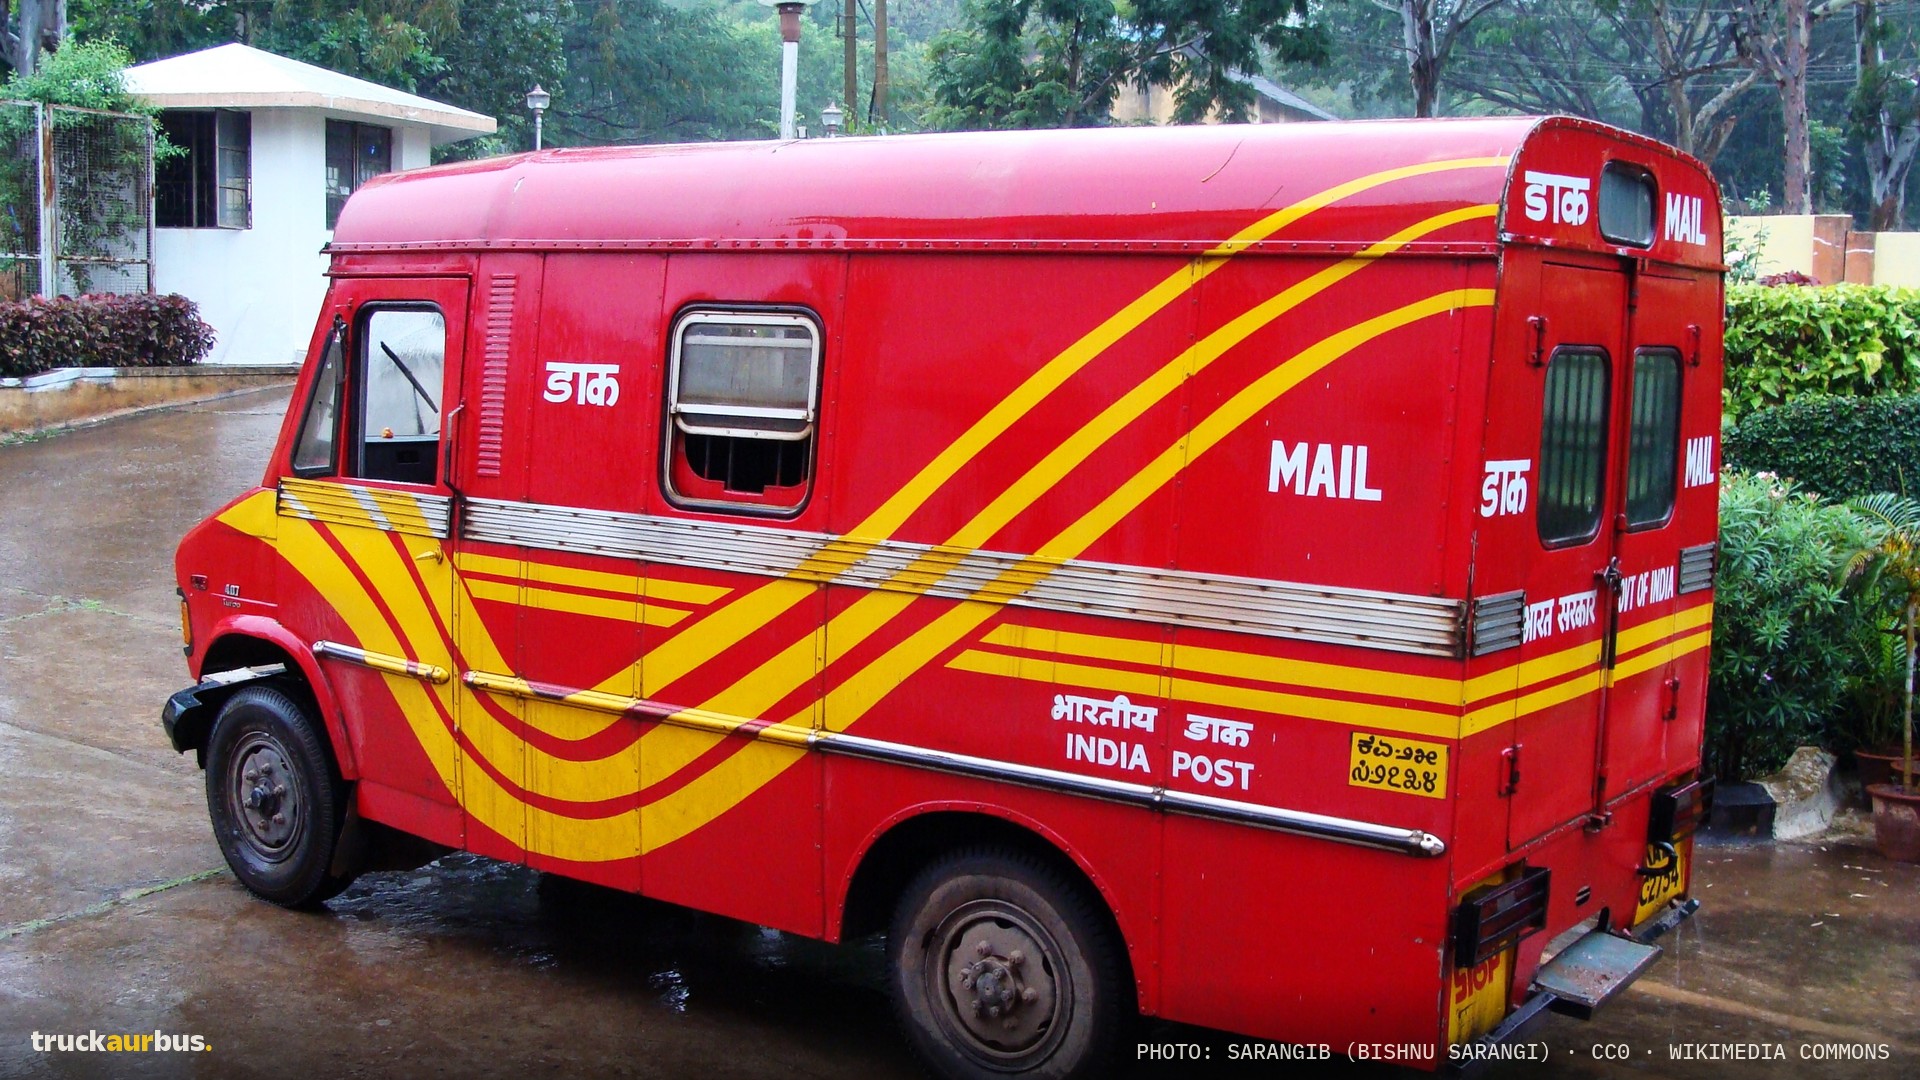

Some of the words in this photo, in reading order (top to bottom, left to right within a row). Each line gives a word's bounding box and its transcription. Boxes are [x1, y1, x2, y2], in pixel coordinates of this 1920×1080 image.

[1525, 170, 1590, 226] डाक
[1665, 192, 1707, 246] MAIL
[543, 361, 620, 407] डाक
[1268, 439, 1382, 502] MAIL
[1480, 459, 1531, 518] डाक
[1684, 436, 1715, 488] MAIL
[1557, 589, 1598, 634] सरकार
[1637, 571, 1650, 608] OF
[1650, 565, 1675, 604] INDIA
[1051, 694, 1159, 733] भारतीय
[1183, 713, 1254, 748] डाक
[1066, 733, 1151, 774] INDIA
[1172, 750, 1255, 791] POST
